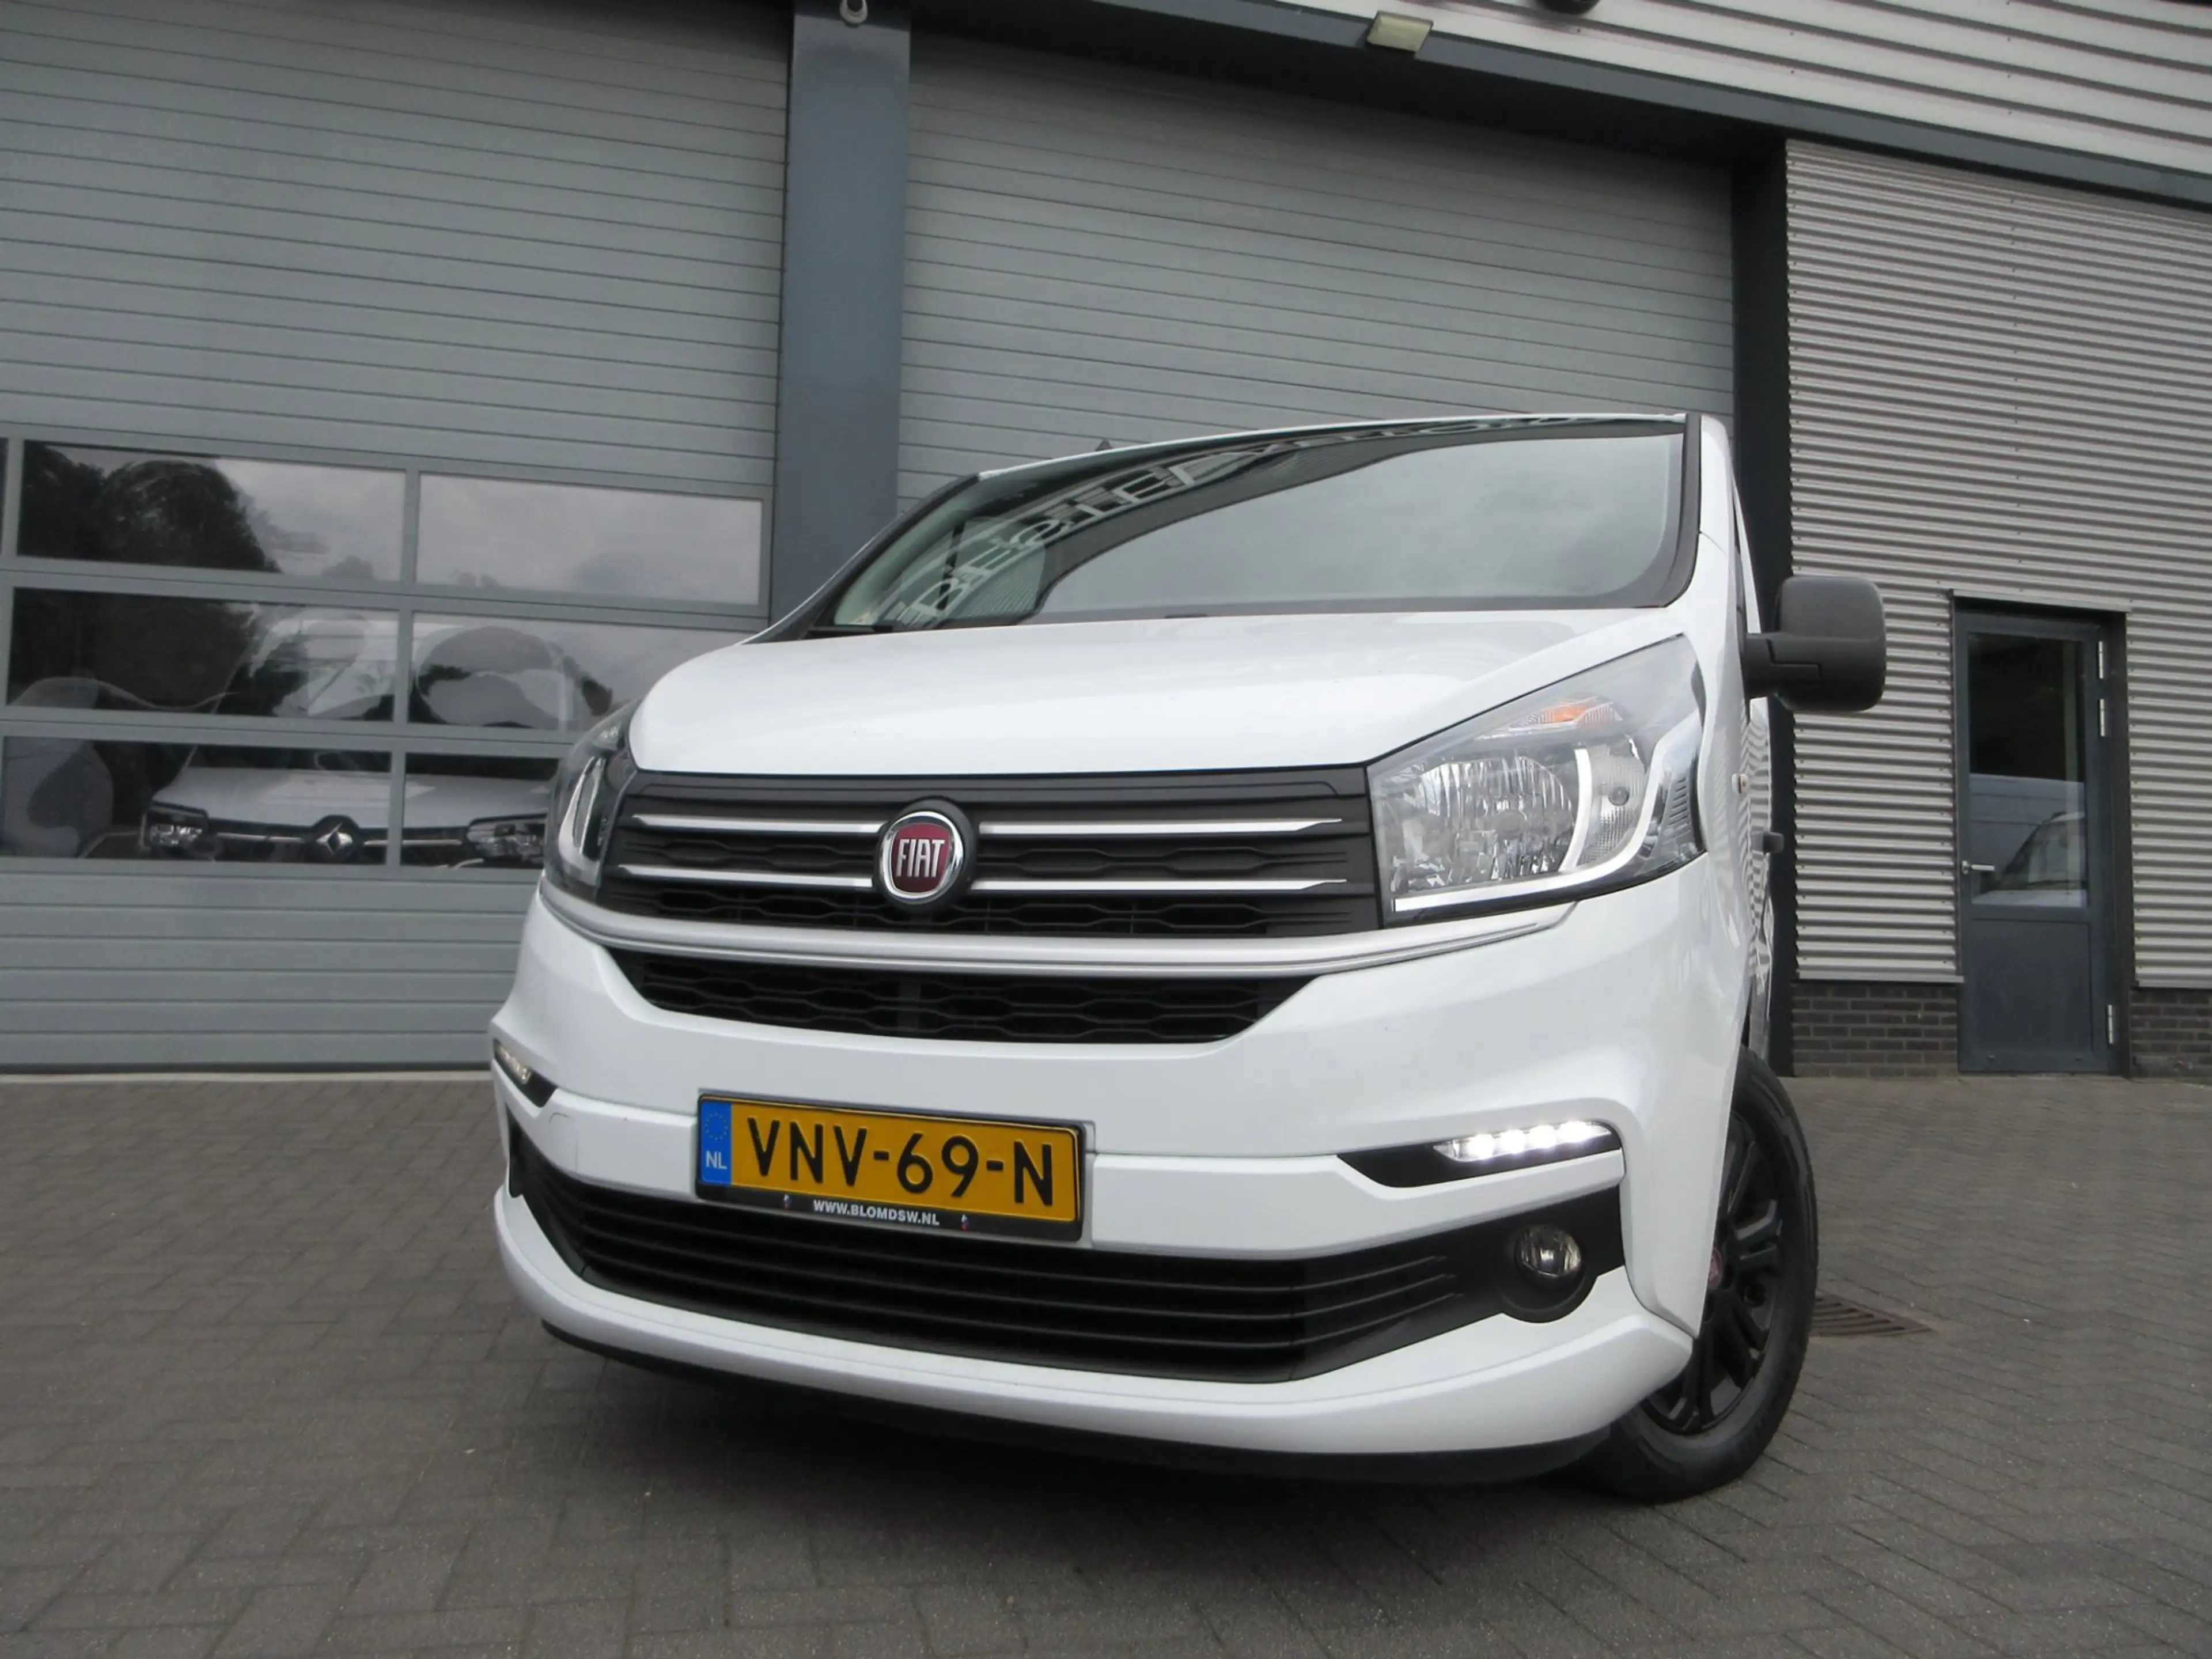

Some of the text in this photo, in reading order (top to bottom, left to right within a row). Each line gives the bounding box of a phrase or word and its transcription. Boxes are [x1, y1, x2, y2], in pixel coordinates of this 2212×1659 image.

[896, 839, 945, 878] FIAT
[706, 1150, 728, 1169] NL
[747, 1117, 1053, 1206] VNV-69-N
[813, 1199, 940, 1226] WWW.BLOMDSW.NL
